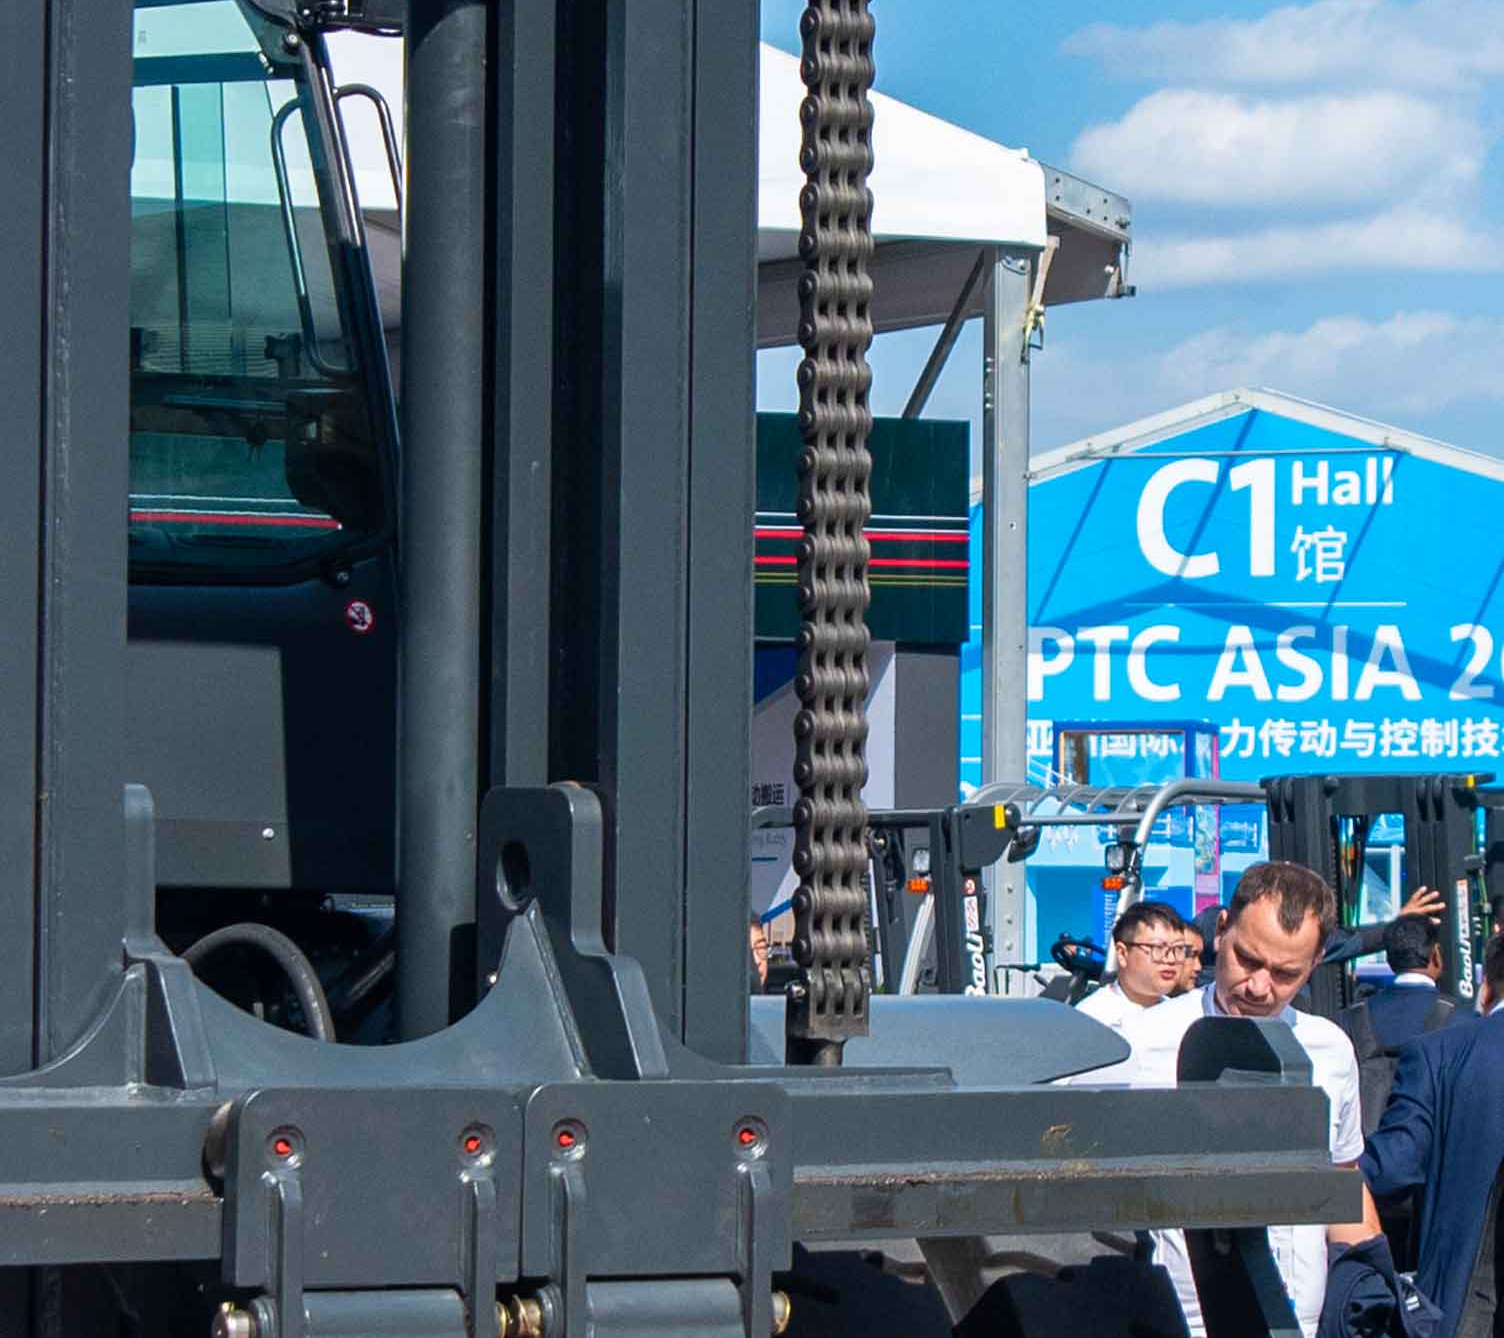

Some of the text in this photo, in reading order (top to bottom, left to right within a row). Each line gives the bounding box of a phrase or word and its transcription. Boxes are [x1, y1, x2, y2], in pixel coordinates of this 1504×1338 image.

[1291, 457, 1393, 505] Hall
[1136, 457, 1276, 579] C1
[1291, 525, 1348, 583] 馆
[1027, 625, 1181, 701] PTC
[1206, 625, 1422, 701] ASIA
